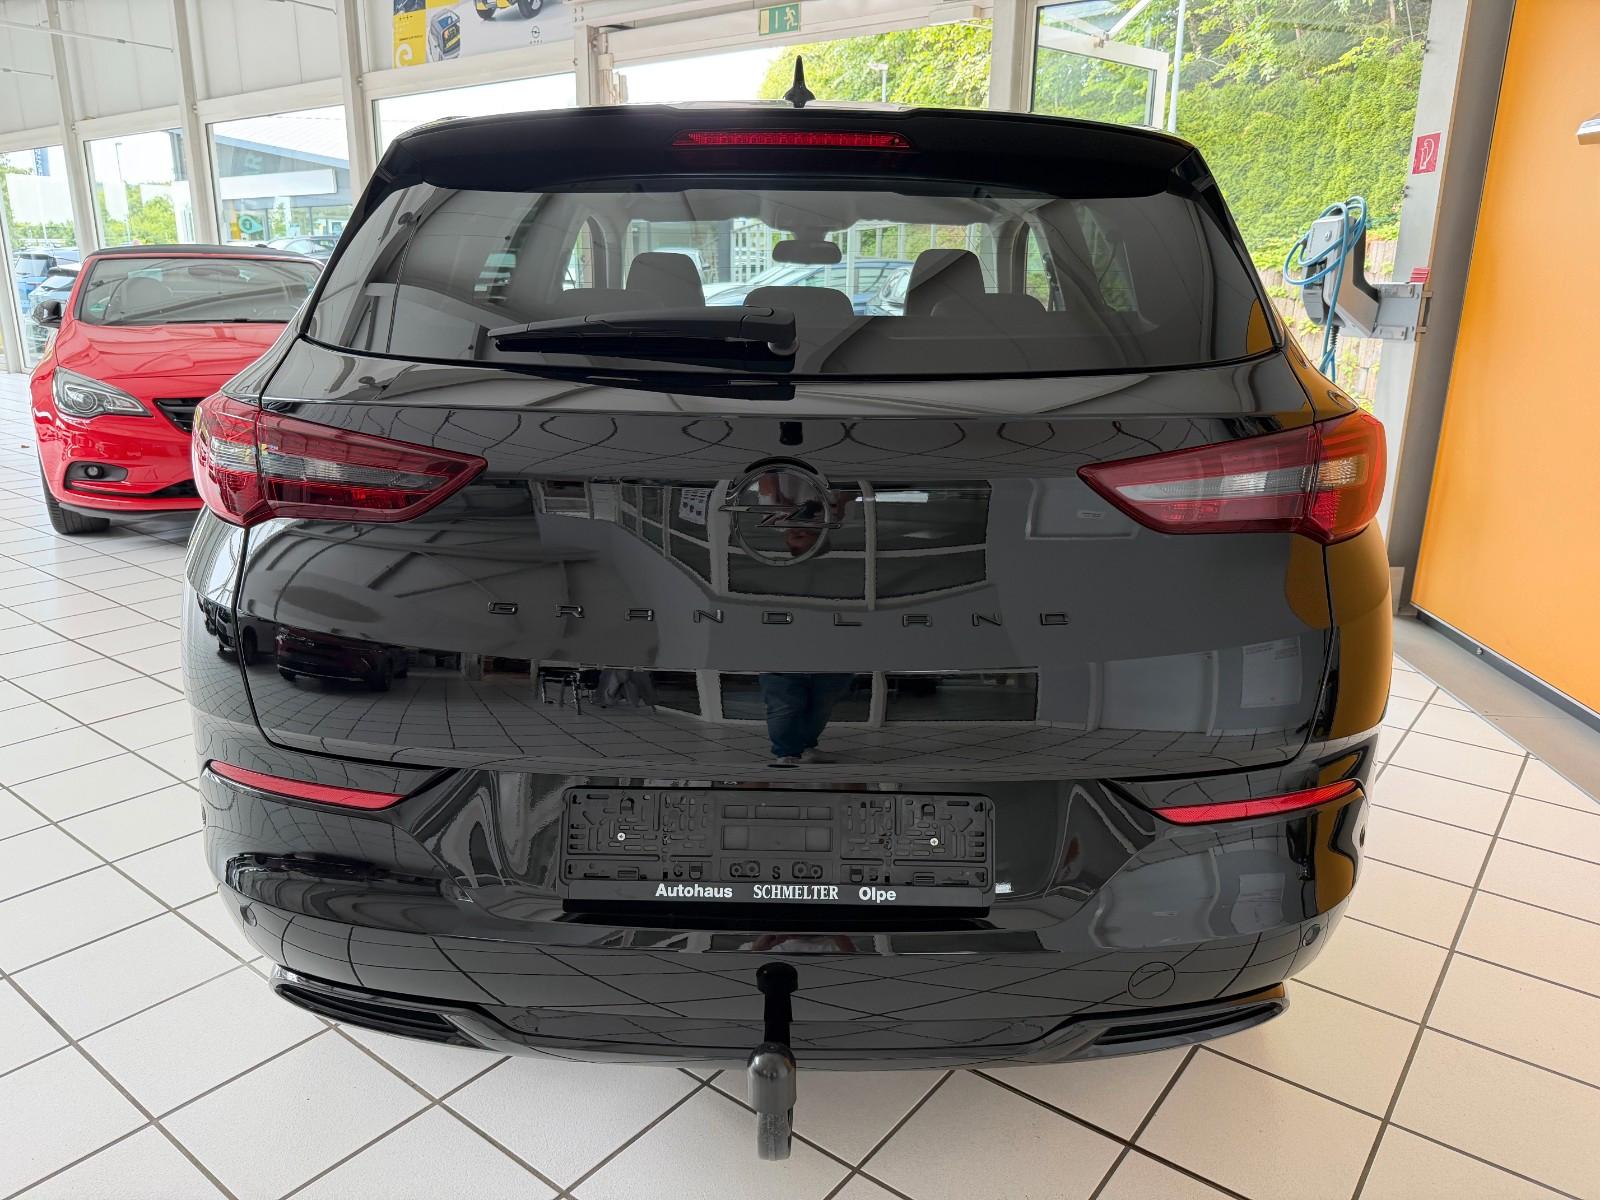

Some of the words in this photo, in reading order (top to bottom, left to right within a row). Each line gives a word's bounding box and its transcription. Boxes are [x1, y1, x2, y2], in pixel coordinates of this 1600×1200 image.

[487, 601, 1070, 627] GRANDLAND
[655, 883, 733, 898] Autohaus
[753, 885, 839, 900] SCHMELTER
[858, 887, 897, 903] Olpe
